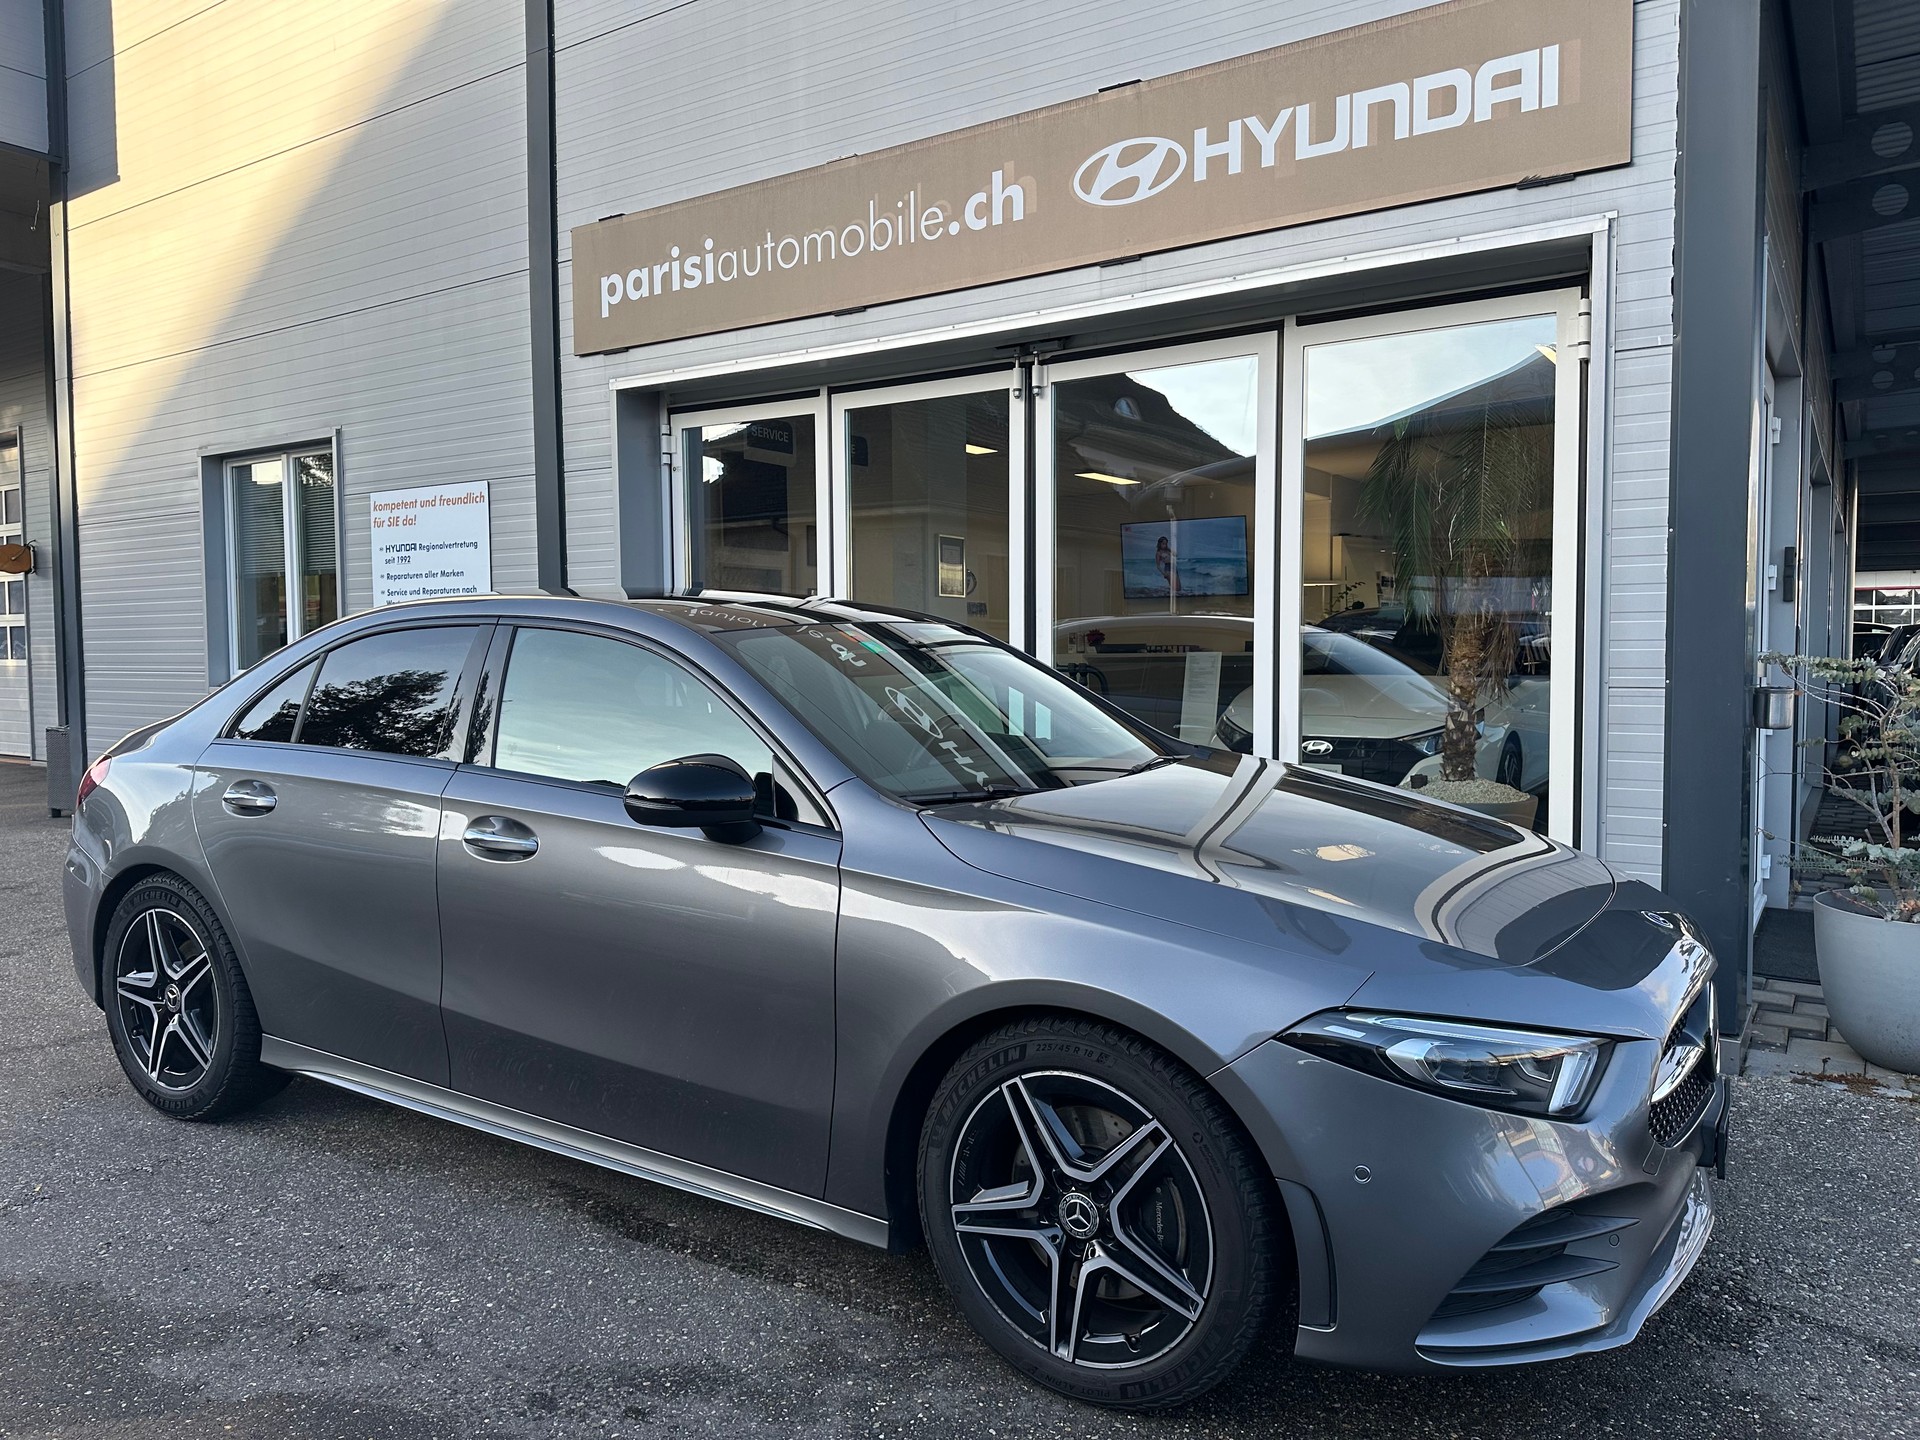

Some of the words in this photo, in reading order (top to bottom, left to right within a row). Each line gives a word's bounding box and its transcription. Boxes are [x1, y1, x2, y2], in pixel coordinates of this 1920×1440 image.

[1193, 43, 1559, 182] HYUNDAI
[600, 170, 1025, 318] parisiautomobile.ch
[752, 425, 789, 442] SERVICE
[373, 498, 417, 513] kompetent
[420, 496, 436, 508] und
[439, 492, 485, 507] freundlich
[373, 517, 385, 528] für
[387, 515, 400, 527] SIE
[402, 514, 417, 526] da!
[385, 542, 417, 553] HYUNDAI
[418, 541, 478, 553] Regionalvertretung
[385, 556, 396, 565] seit
[397, 555, 411, 564] 1992
[386, 571, 423, 581] Reparaturen
[424, 570, 439, 579] aller
[440, 569, 464, 578] Marken
[387, 588, 408, 597] Service
[409, 587, 421, 595] und
[422, 586, 460, 596] Reparaturen
[461, 585, 477, 593] nach
[1036, 1043, 1071, 1053] 225/45
[1073, 1047, 1080, 1055] R
[1083, 1049, 1095, 1058] 18
[941, 1046, 1021, 1121] MICHELIN
[1080, 1387, 1110, 1397] PILOT
